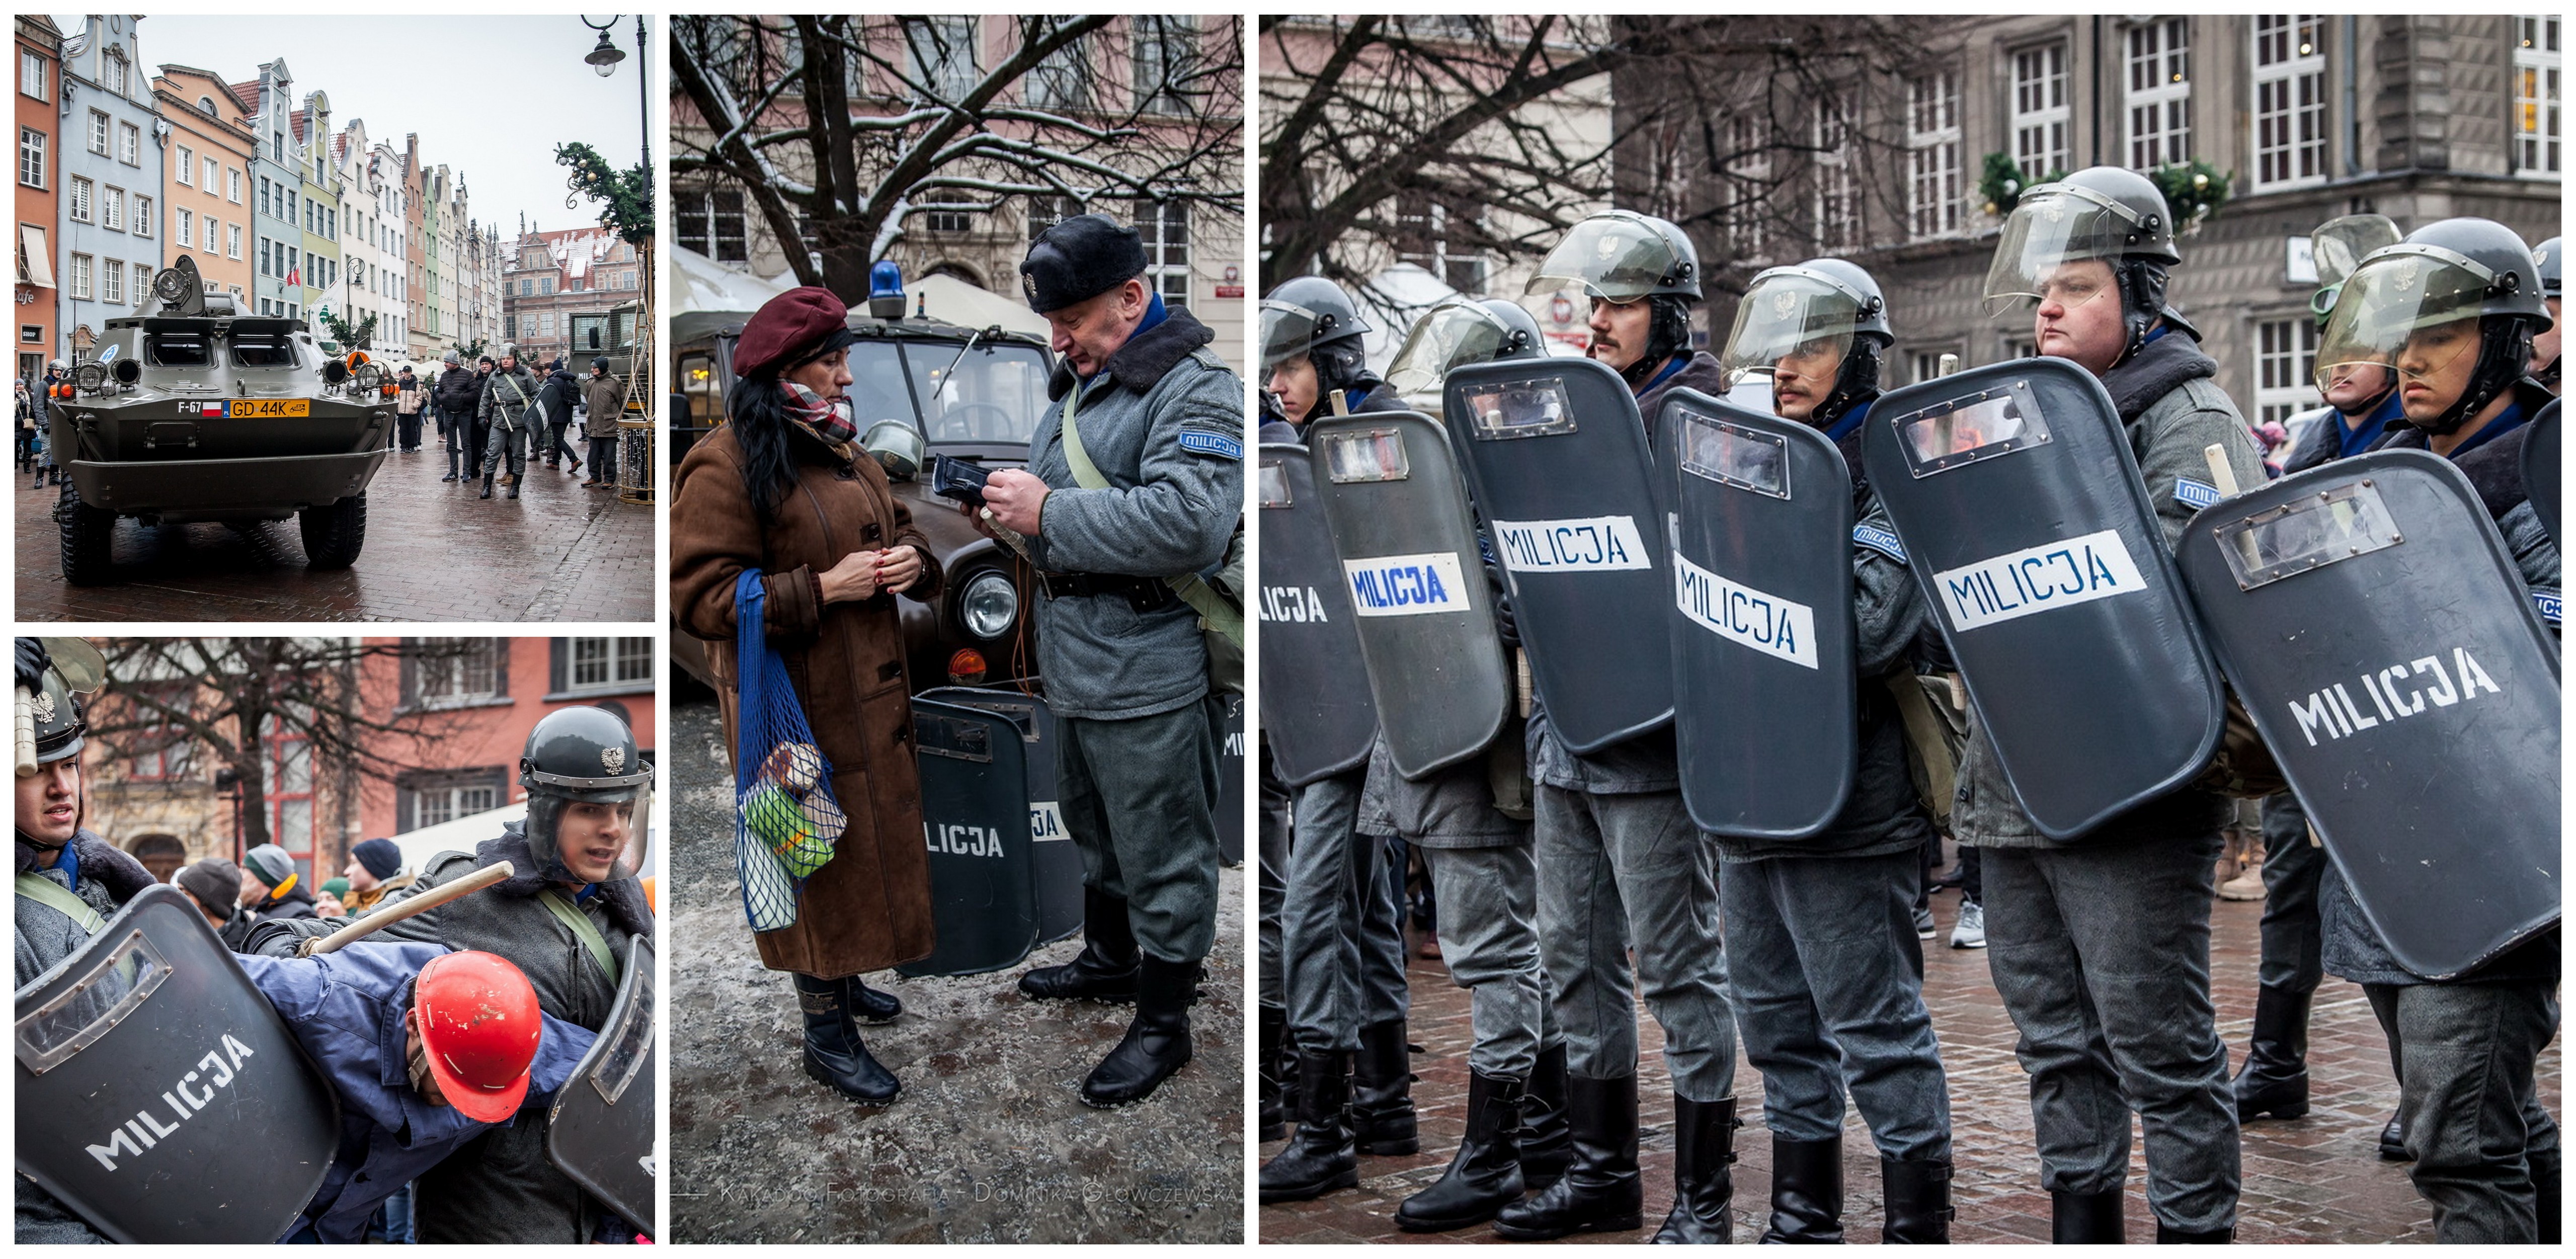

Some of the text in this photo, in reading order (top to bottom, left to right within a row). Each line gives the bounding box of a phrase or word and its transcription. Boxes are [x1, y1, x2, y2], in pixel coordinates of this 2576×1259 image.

[178, 401, 201, 413] F-67
[233, 402, 287, 416] GD 44K
[1186, 435, 1237, 454] MILICJA
[2184, 485, 2220, 503] MILIC
[1501, 525, 1629, 566] MILICJA
[1351, 565, 1448, 608] MILICJA
[1949, 545, 2116, 619] MILICJA
[1259, 586, 1328, 622] LICJA
[1681, 564, 1796, 654] MILICJA
[2288, 647, 2501, 746] MILICJA
[923, 821, 1004, 857] LICJA
[85, 1034, 254, 1171] MILICJA
